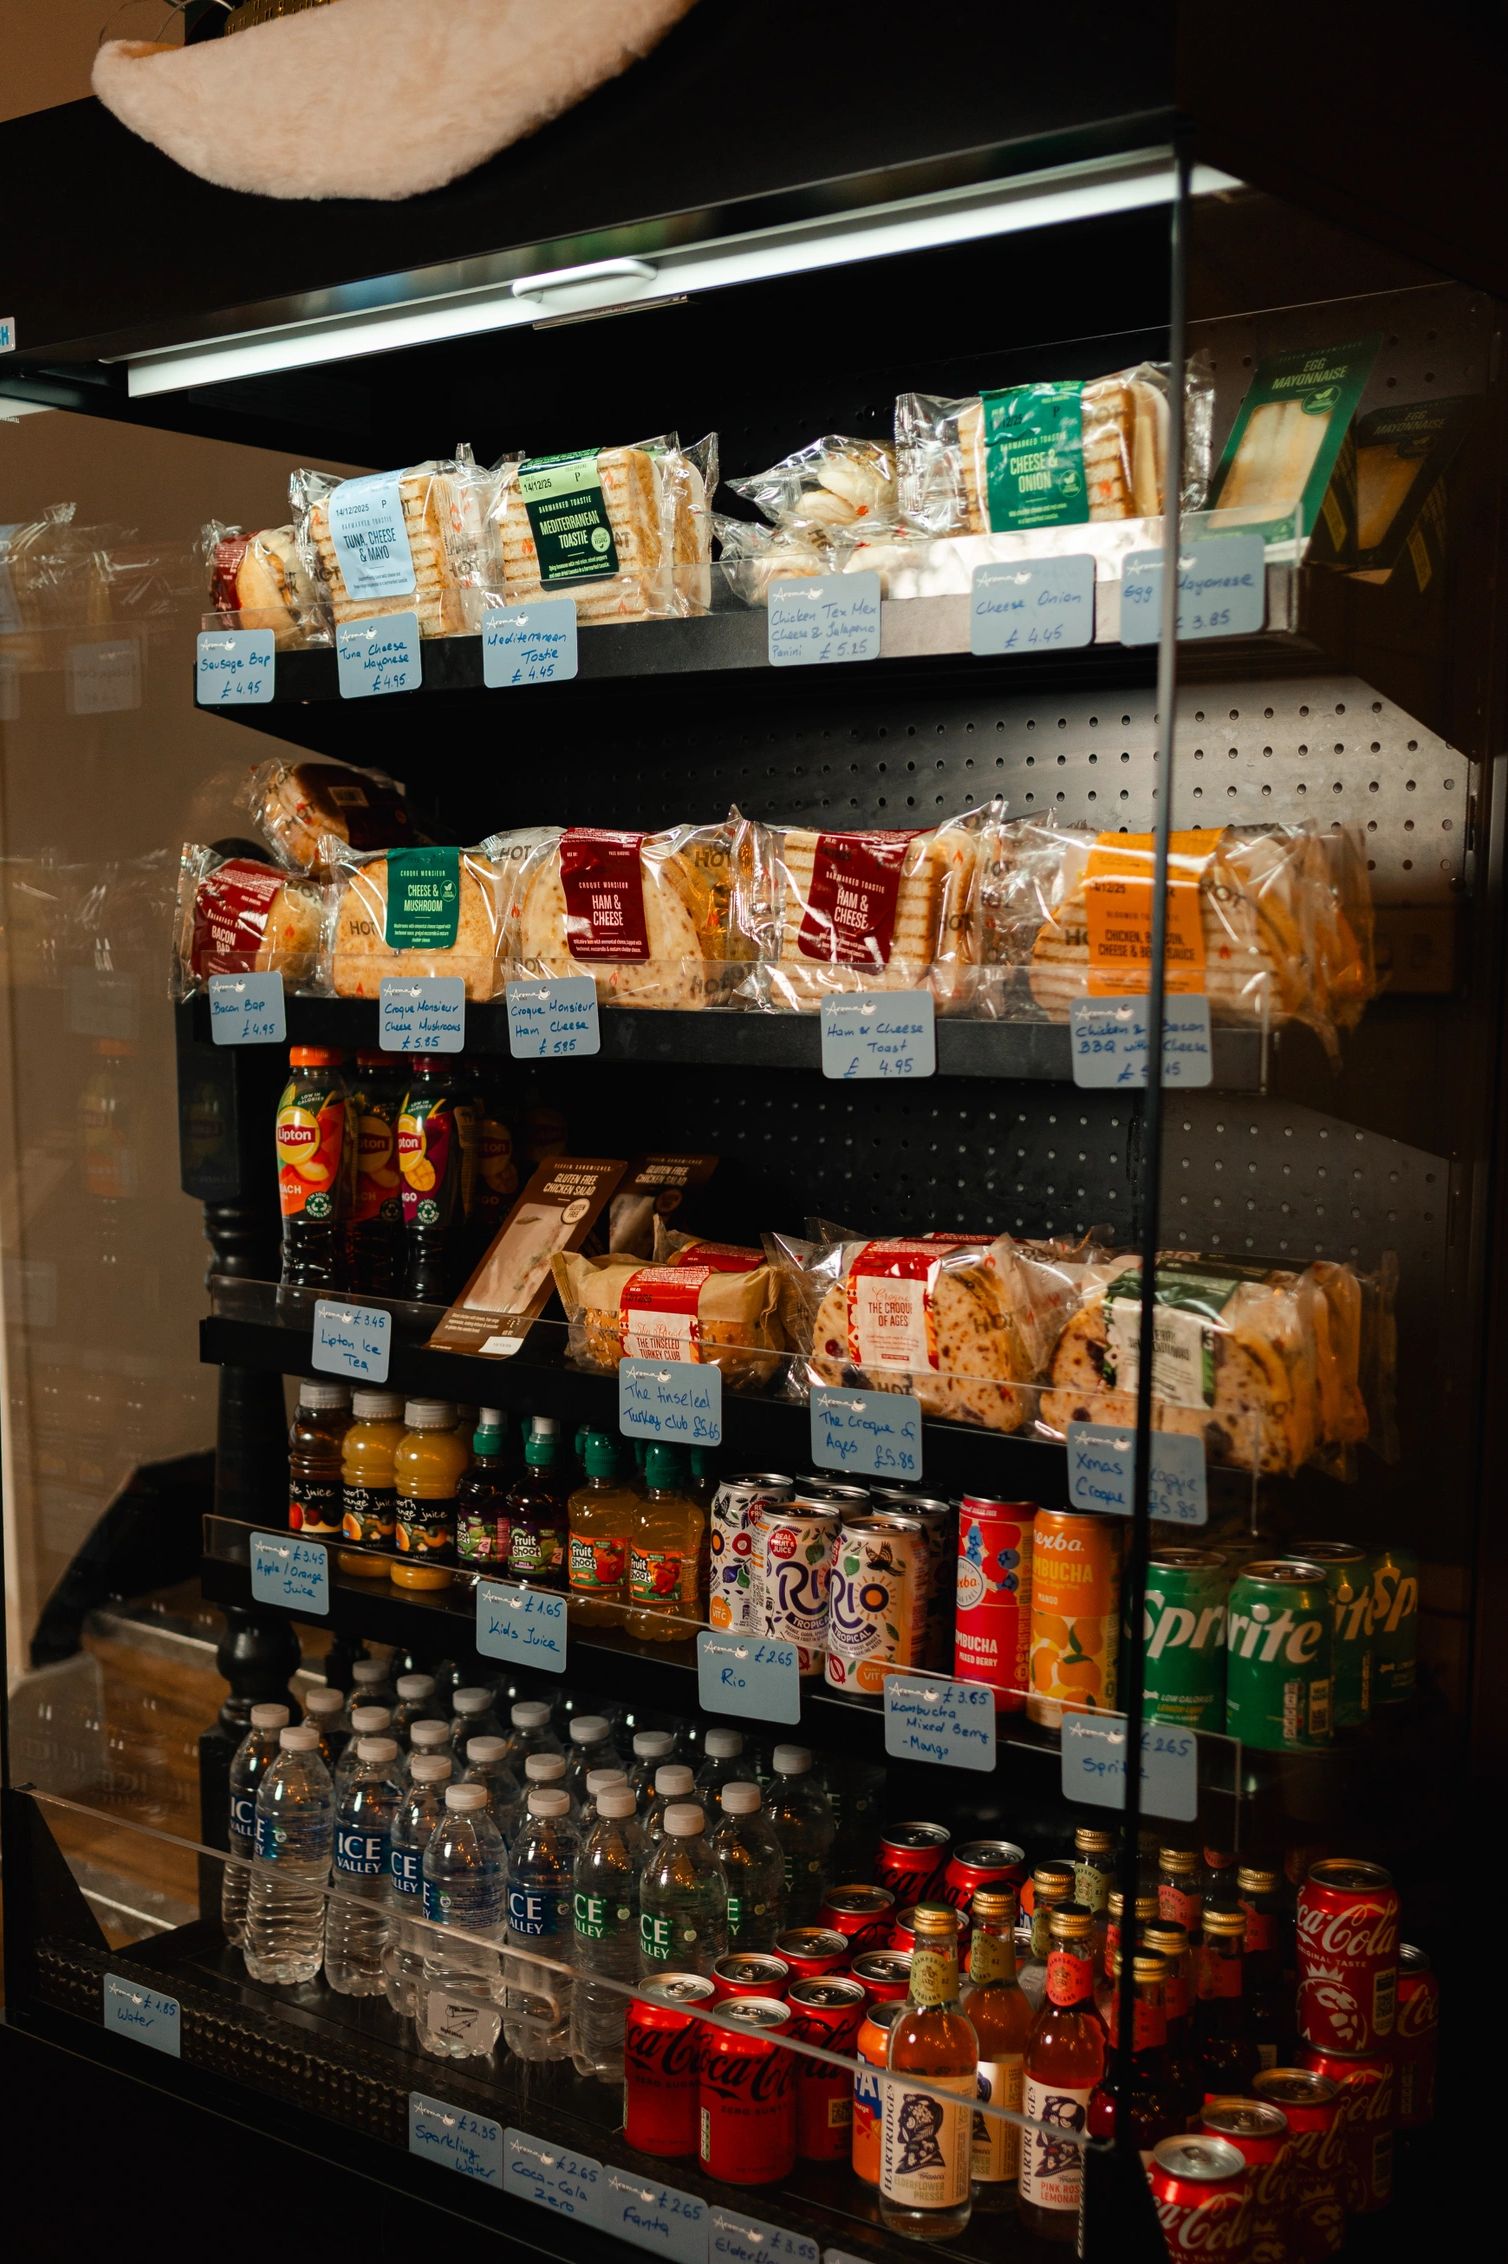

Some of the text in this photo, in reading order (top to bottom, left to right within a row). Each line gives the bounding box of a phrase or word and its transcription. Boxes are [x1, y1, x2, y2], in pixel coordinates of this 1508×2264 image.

[1302, 357, 1327, 373] EGG
[1271, 365, 1349, 390] MAYONNAISE
[1010, 448, 1058, 475] CHEESE &
[523, 478, 552, 493] 14/12/25
[1018, 469, 1052, 493] ONION
[336, 503, 370, 517] 14/12/2025
[570, 495, 592, 508] TOASTIE
[539, 509, 600, 535] MEDITERRANEAN
[368, 527, 397, 545] CHEESE
[558, 529, 589, 550] TOASTIE
[360, 544, 390, 563] & MAYO
[771, 597, 877, 626] Chicken Tex Mex
[974, 590, 1082, 616] Cheese Onion
[771, 628, 808, 642] Cheese
[339, 640, 408, 660] Tuna Cheese
[520, 648, 559, 665] Tostie
[771, 645, 802, 660] Panini
[200, 652, 272, 674] Sausage Bap
[499, 844, 532, 861] HOT
[407, 884, 439, 897] CHEESE &
[578, 881, 630, 889] CROQUE MONSIEUR
[861, 879, 885, 894] TOASTIE
[403, 899, 443, 913] MUSHROOM
[592, 894, 622, 910] HAM &
[836, 887, 869, 912] HAM &
[593, 911, 624, 927] CHEESE
[834, 906, 868, 931] CHEESE
[211, 924, 236, 946] BACON
[1097, 943, 1129, 958] CHEESE
[212, 998, 266, 1015] Bacon Bap
[384, 1000, 459, 1020] Croque Monsieur
[510, 999, 595, 1020] Croque Monsieur
[384, 1018, 461, 1032] Cheese Mushrooms
[515, 1020, 589, 1037] Ham Cheese
[827, 1023, 855, 1038] Ham
[876, 1022, 925, 1034] Cheese
[1075, 1021, 1128, 1037] Chicken
[866, 1039, 909, 1054] Toast
[278, 1128, 312, 1143] Lipton
[553, 1172, 599, 1186] GLUTEN FREE
[671, 1166, 690, 1177] FREE
[542, 1182, 597, 1197] CHICKEN SALAD
[867, 1302, 884, 1314] THE
[878, 1314, 909, 1328] OF AGES
[320, 1328, 382, 1356] Lipton Ice
[636, 1337, 681, 1350] THE TINSELED
[343, 1353, 369, 1373] Tea
[639, 1348, 682, 1361] TURKEY CLUB
[624, 1380, 711, 1409] The tinseled
[664, 1414, 688, 1430] club
[818, 1410, 918, 1441] The Croque of
[826, 1432, 859, 1461] Ages
[1075, 1452, 1125, 1475] Xmas
[304, 1483, 336, 1501] juice
[1075, 1476, 1127, 1505] Croque
[419, 1507, 449, 1522] juice
[514, 1535, 537, 1547] Fruit
[775, 1532, 793, 1542] REAL
[512, 1545, 542, 1558] Shoot
[572, 1545, 593, 1558] Fruit
[772, 1545, 793, 1555] JUICE
[256, 1557, 324, 1585] Apple Orange
[571, 1556, 597, 1570] Shoot
[1033, 1555, 1094, 1584] MBUCHA
[282, 1578, 316, 1598] Juice
[1037, 1592, 1058, 1606] MANGO
[488, 1615, 561, 1653] Kids Juice
[832, 1623, 873, 1643] TROPICAL
[1228, 1603, 1324, 1665] rite
[955, 1630, 998, 1654] MBUCHA
[959, 1653, 998, 1668] MIXED BERRY
[721, 1667, 746, 1688] Rio
[864, 1671, 881, 1681] VIT
[890, 1701, 957, 1720] Kombucha
[906, 1716, 992, 1745] Mixed Berry
[337, 1831, 382, 1861] ICE
[335, 1856, 382, 1874] VALLEY
[117, 2006, 155, 2030] Water
[415, 2124, 482, 2165] Sparkling
[454, 2156, 498, 2181] Water
[894, 2178, 945, 2192] ELDERFLOWER
[1040, 2181, 1080, 2196] PINK ROS
[913, 2190, 945, 2202] PRESSE
[1040, 2190, 1080, 2205] LEMONAD
[621, 2205, 671, 2239] Fanta
